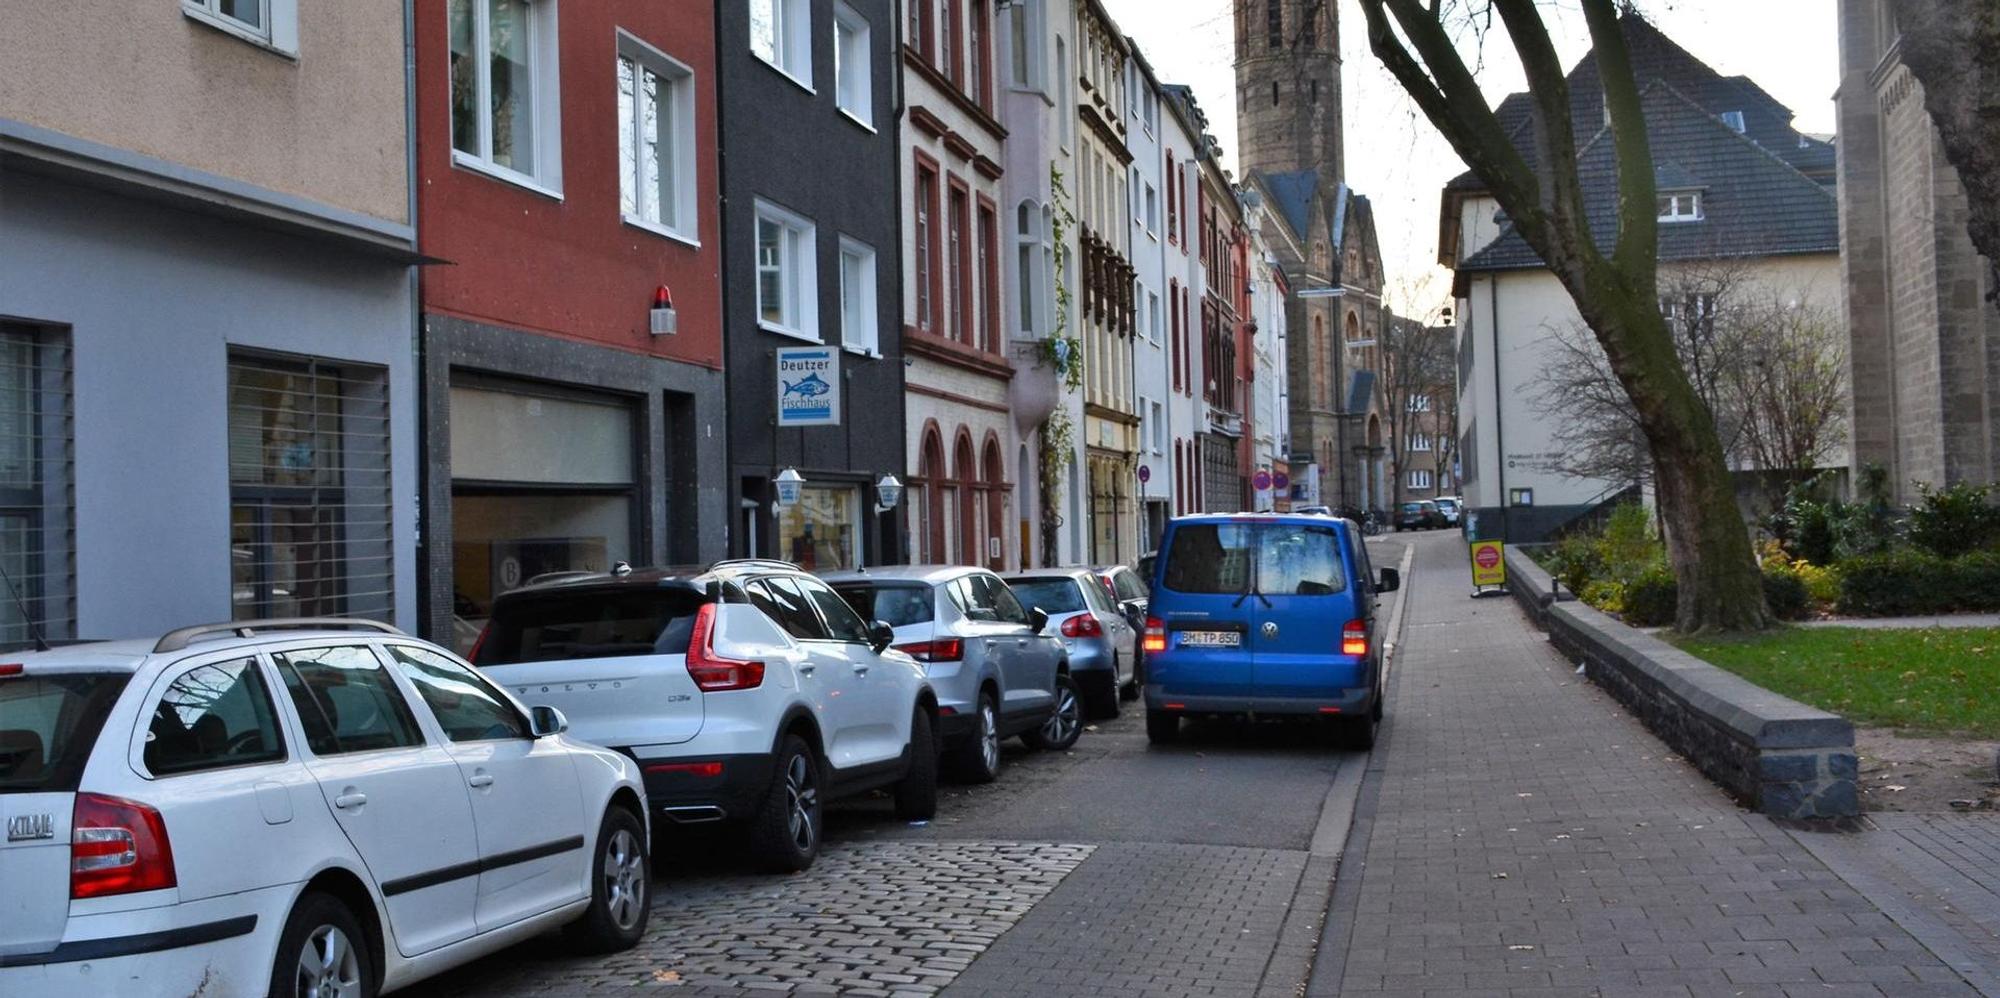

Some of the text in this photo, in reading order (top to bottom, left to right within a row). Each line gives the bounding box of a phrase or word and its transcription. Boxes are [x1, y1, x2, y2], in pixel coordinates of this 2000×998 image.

[781, 360, 829, 371] Deutzer
[781, 397, 831, 409] Fischhaus
[1203, 631, 1217, 644] TP
[1218, 632, 1239, 644] 850
[517, 681, 621, 694] VOLVO
